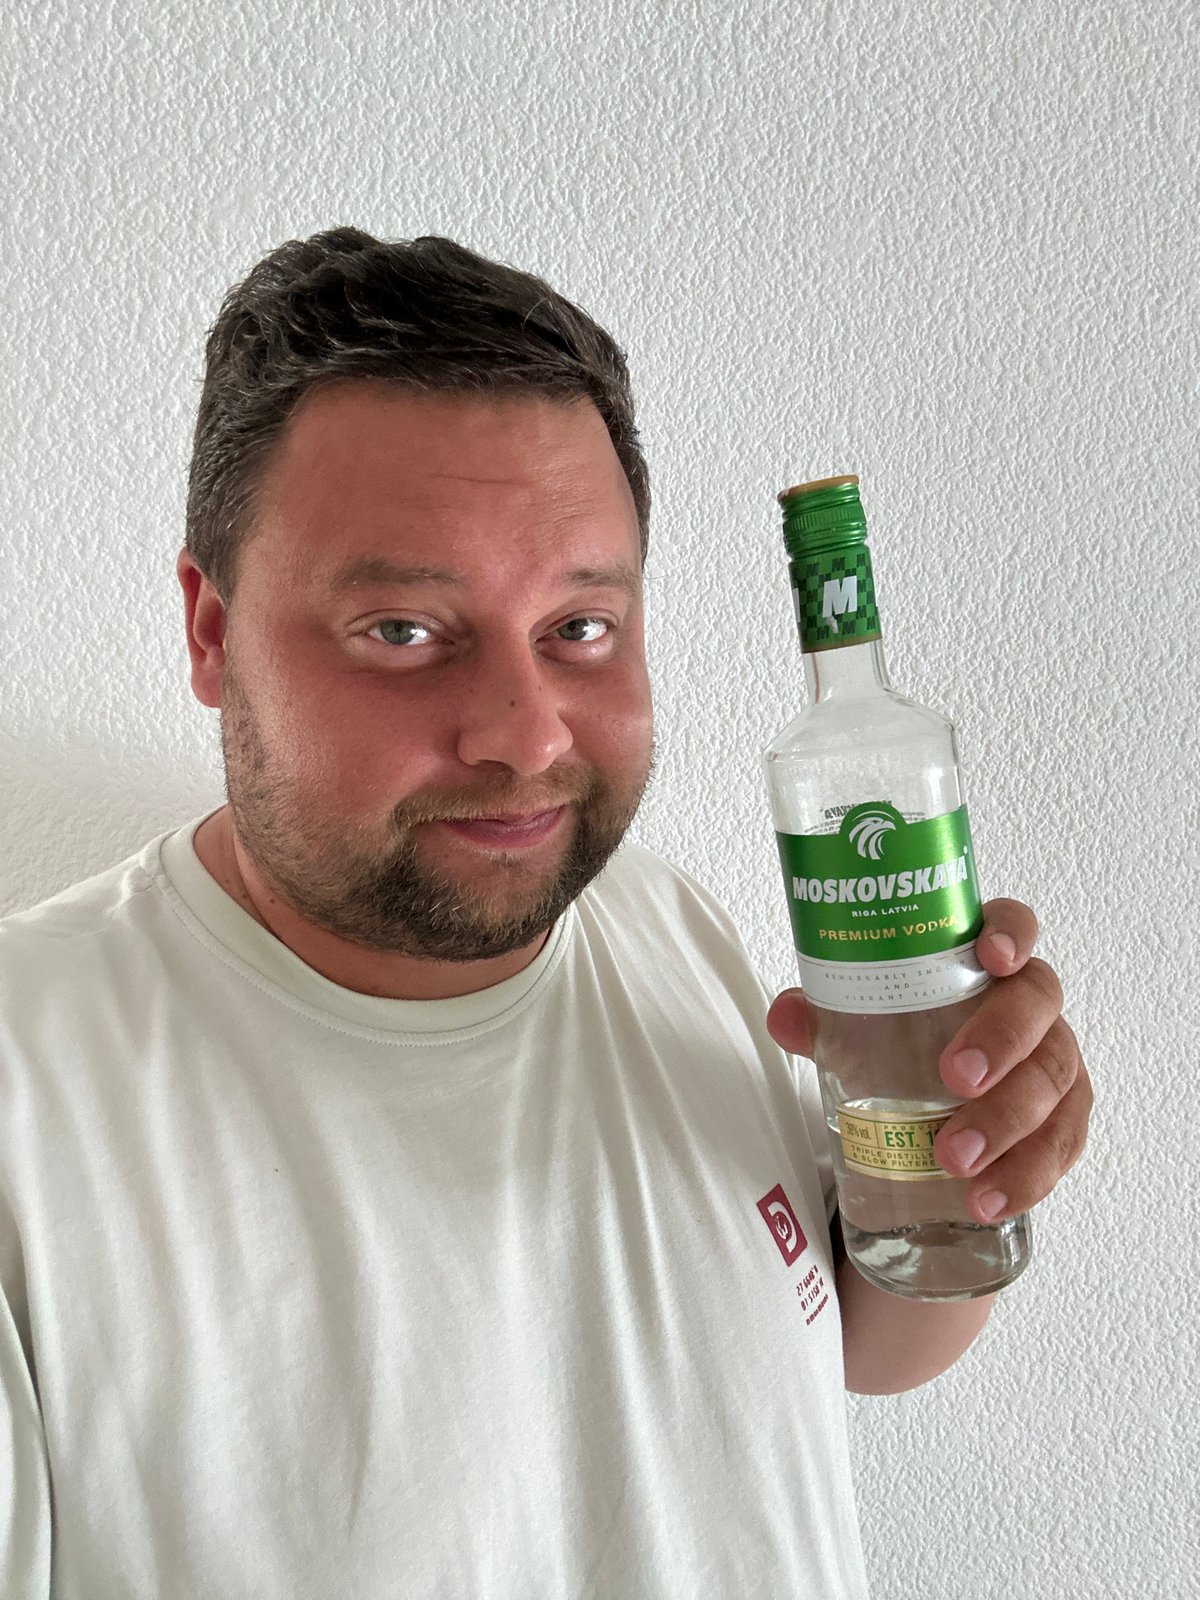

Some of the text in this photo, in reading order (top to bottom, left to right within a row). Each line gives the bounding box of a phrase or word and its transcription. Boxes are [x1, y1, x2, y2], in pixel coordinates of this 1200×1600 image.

[822, 575, 858, 617] M
[792, 855, 968, 904] MOSKOVSKAYA
[851, 904, 919, 918] RIGA LATVIA
[818, 915, 958, 942] PREMIUM VODKA
[884, 982, 910, 991] AND
[883, 1130, 920, 1148] EST.
[850, 1144, 935, 1160] TRIPLE DISTILLE
[861, 1155, 887, 1166] SLOW
[891, 1159, 937, 1168] FILTERE
